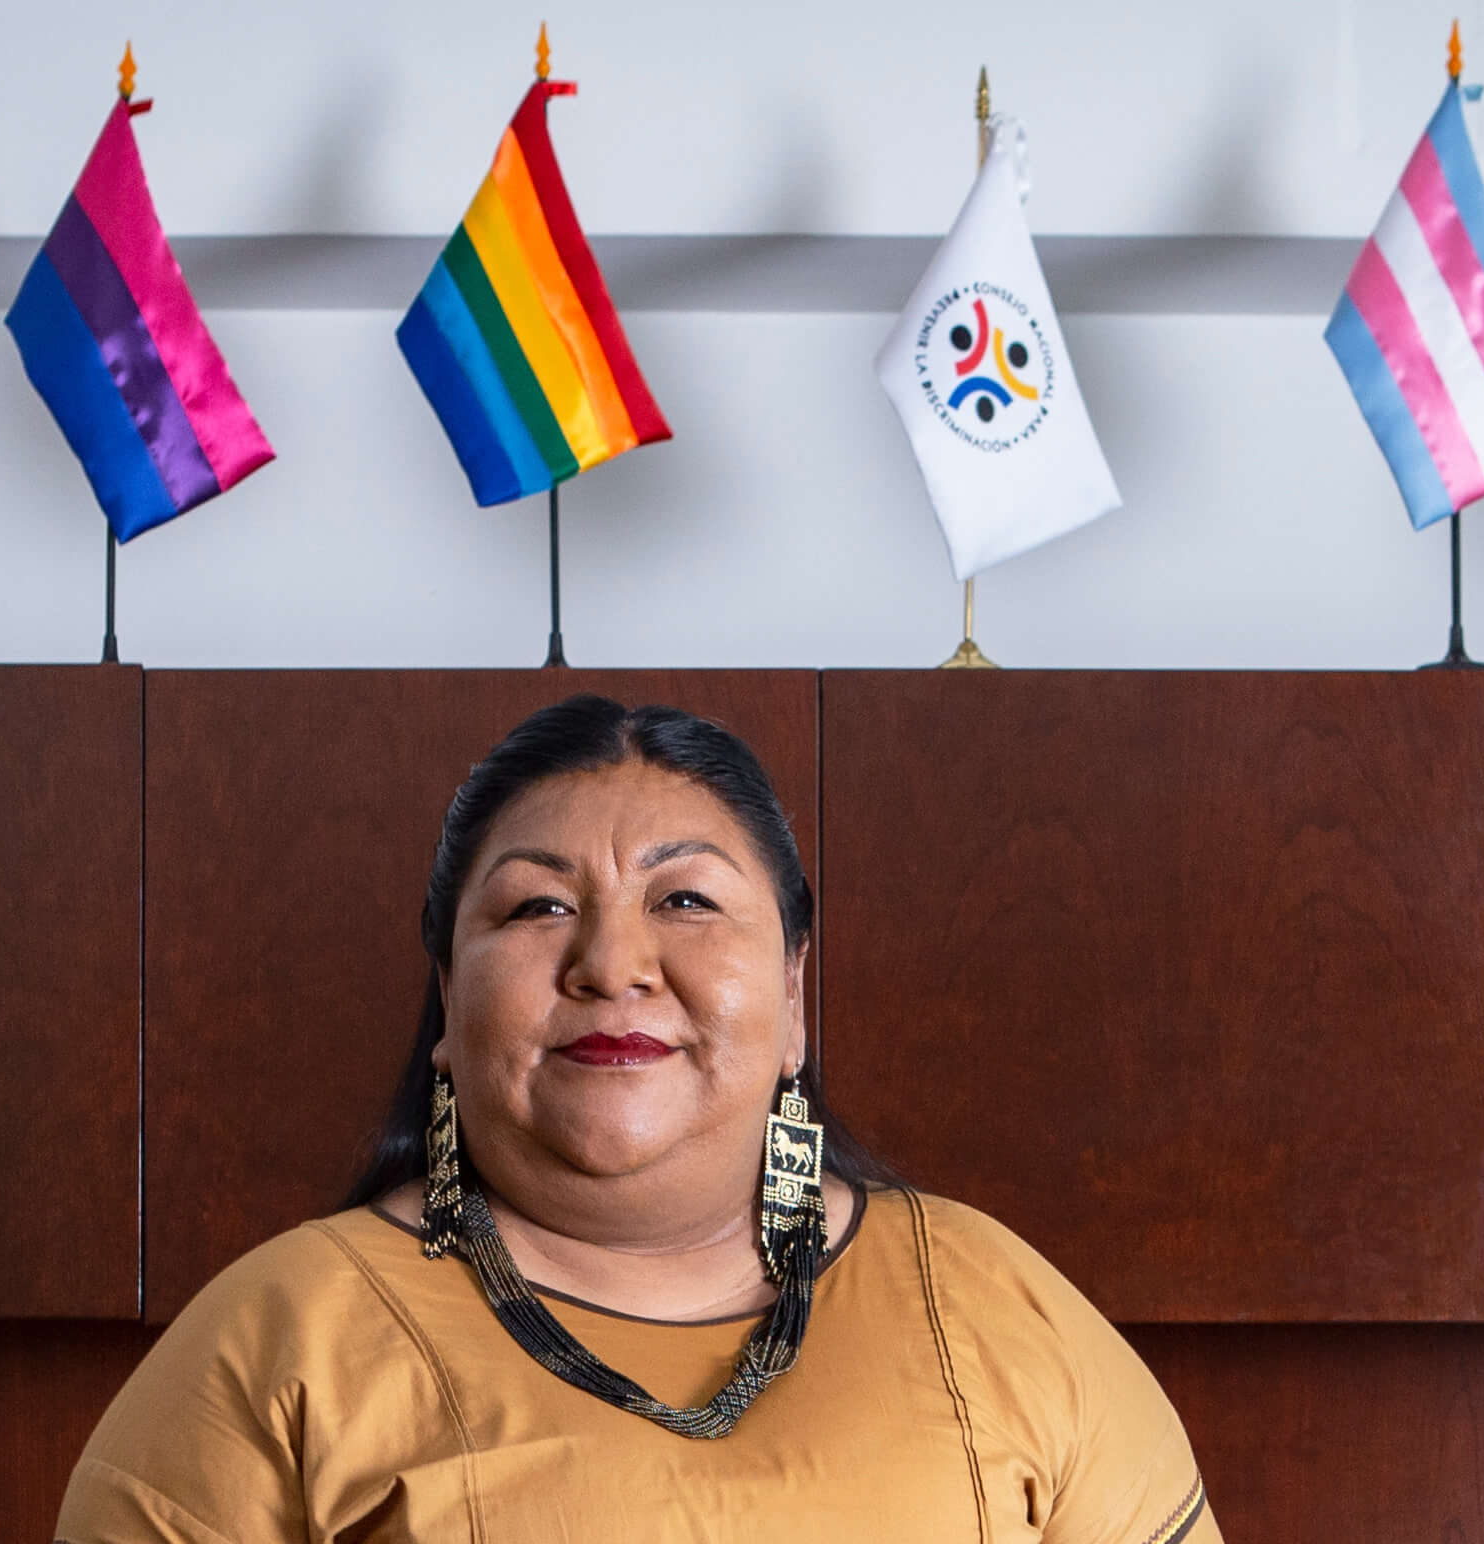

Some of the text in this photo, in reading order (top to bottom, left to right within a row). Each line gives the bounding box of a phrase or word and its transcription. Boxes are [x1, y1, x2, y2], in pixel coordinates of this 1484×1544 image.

[915, 289, 1011, 453] PREVENIR LA DISCRIMINACIÓN
[973, 282, 1054, 439] CONSEJO NACIONAL PARA
